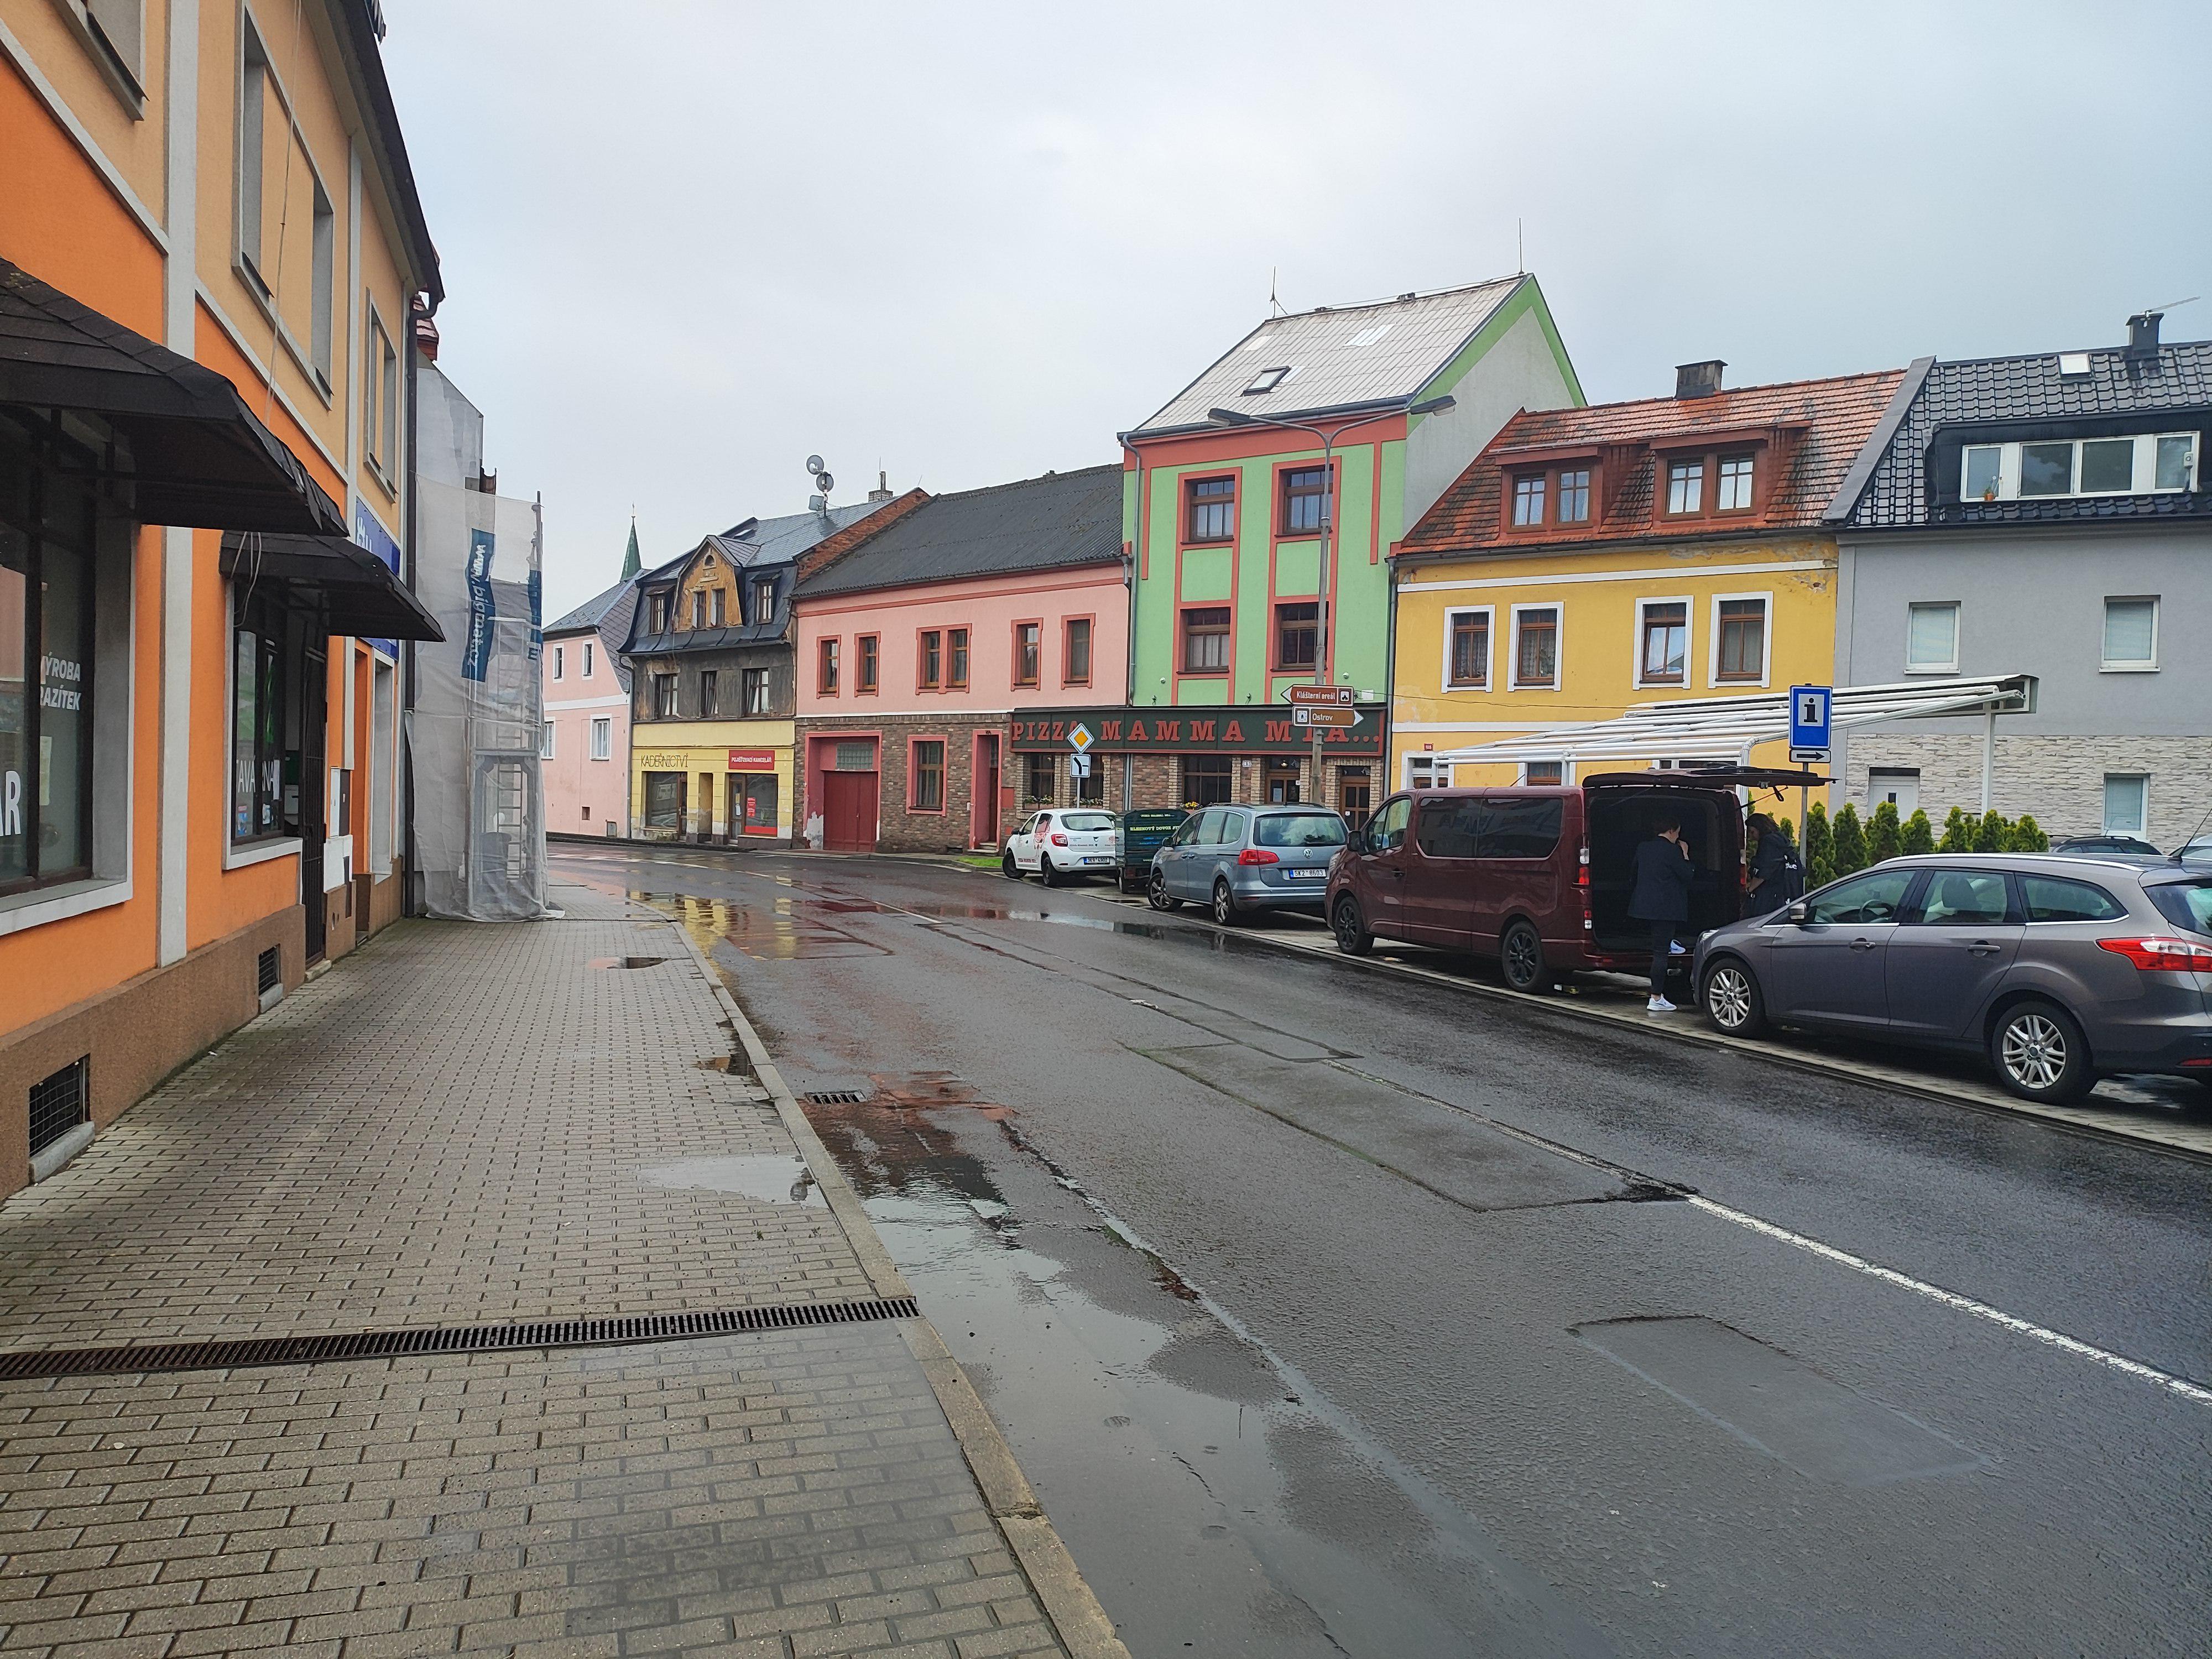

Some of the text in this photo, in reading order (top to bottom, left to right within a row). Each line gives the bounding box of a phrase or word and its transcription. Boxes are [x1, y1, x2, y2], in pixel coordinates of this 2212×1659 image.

[468, 544, 488, 667] www.bigmat.cz
[1296, 691, 1321, 699] Klášterní
[1100, 720, 1246, 742] MAMMA
[641, 753, 688, 768] KADEŘNICTVÍ
[0, 770, 21, 836] R
